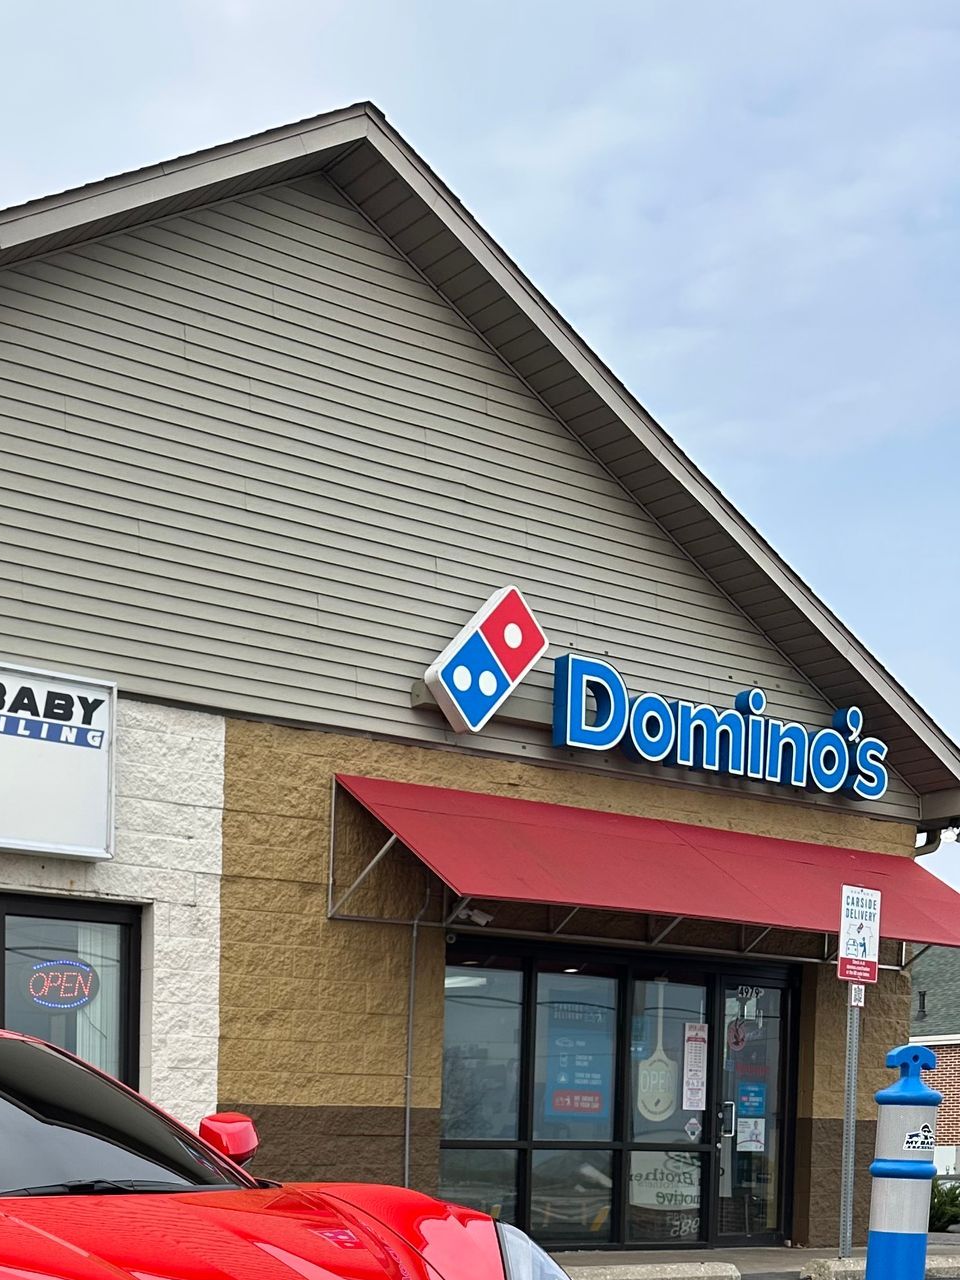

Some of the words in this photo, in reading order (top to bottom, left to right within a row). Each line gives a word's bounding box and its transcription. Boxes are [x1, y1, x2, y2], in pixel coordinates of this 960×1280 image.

[566, 653, 888, 800] Domino's
[846, 895, 877, 911] CARSIDE
[845, 908, 877, 923] DELIVERY
[29, 972, 93, 997] OPEN
